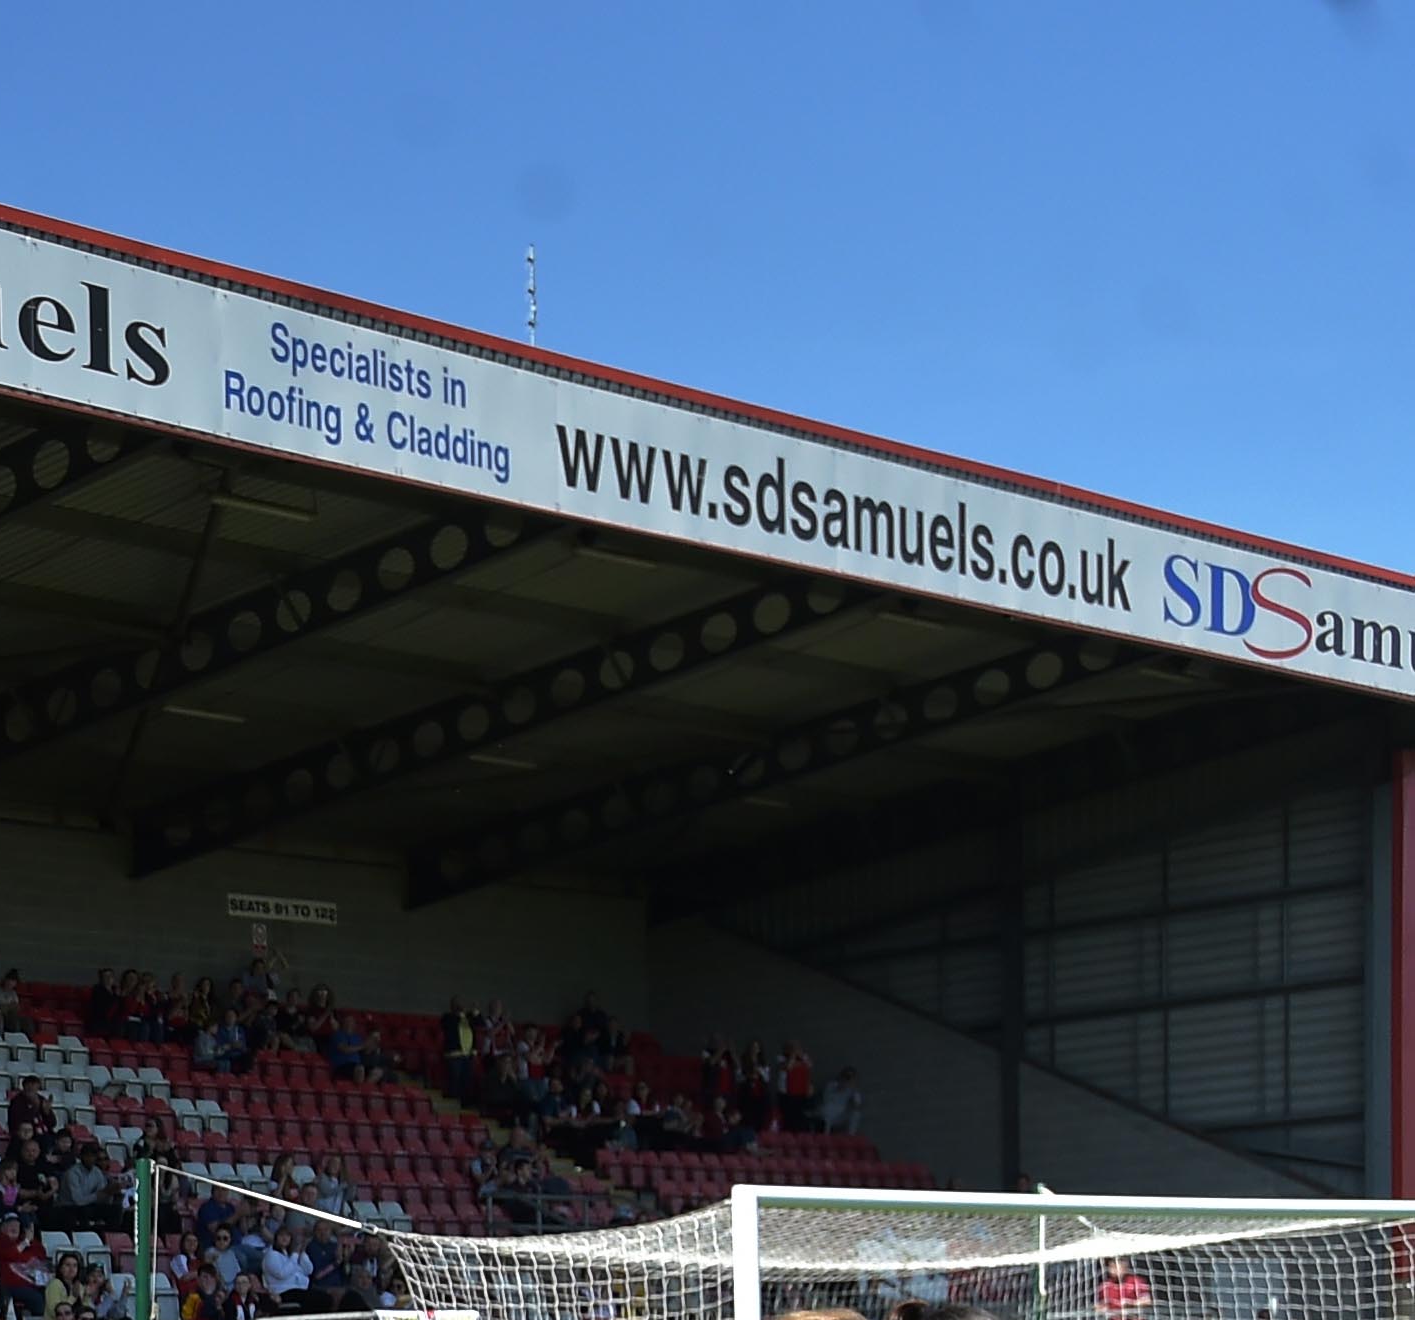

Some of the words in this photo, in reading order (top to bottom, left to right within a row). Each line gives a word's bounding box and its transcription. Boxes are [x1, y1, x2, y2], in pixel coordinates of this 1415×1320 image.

[270, 323, 432, 402] Specialists
[441, 367, 467, 410] in
[223, 370, 343, 447] Roofing
[354, 405, 375, 444] &
[386, 411, 511, 484] Cladding
[558, 424, 1132, 613] www.sdsamuels.co.uk
[230, 898, 270, 914] SEATS
[292, 905, 310, 917] TO
